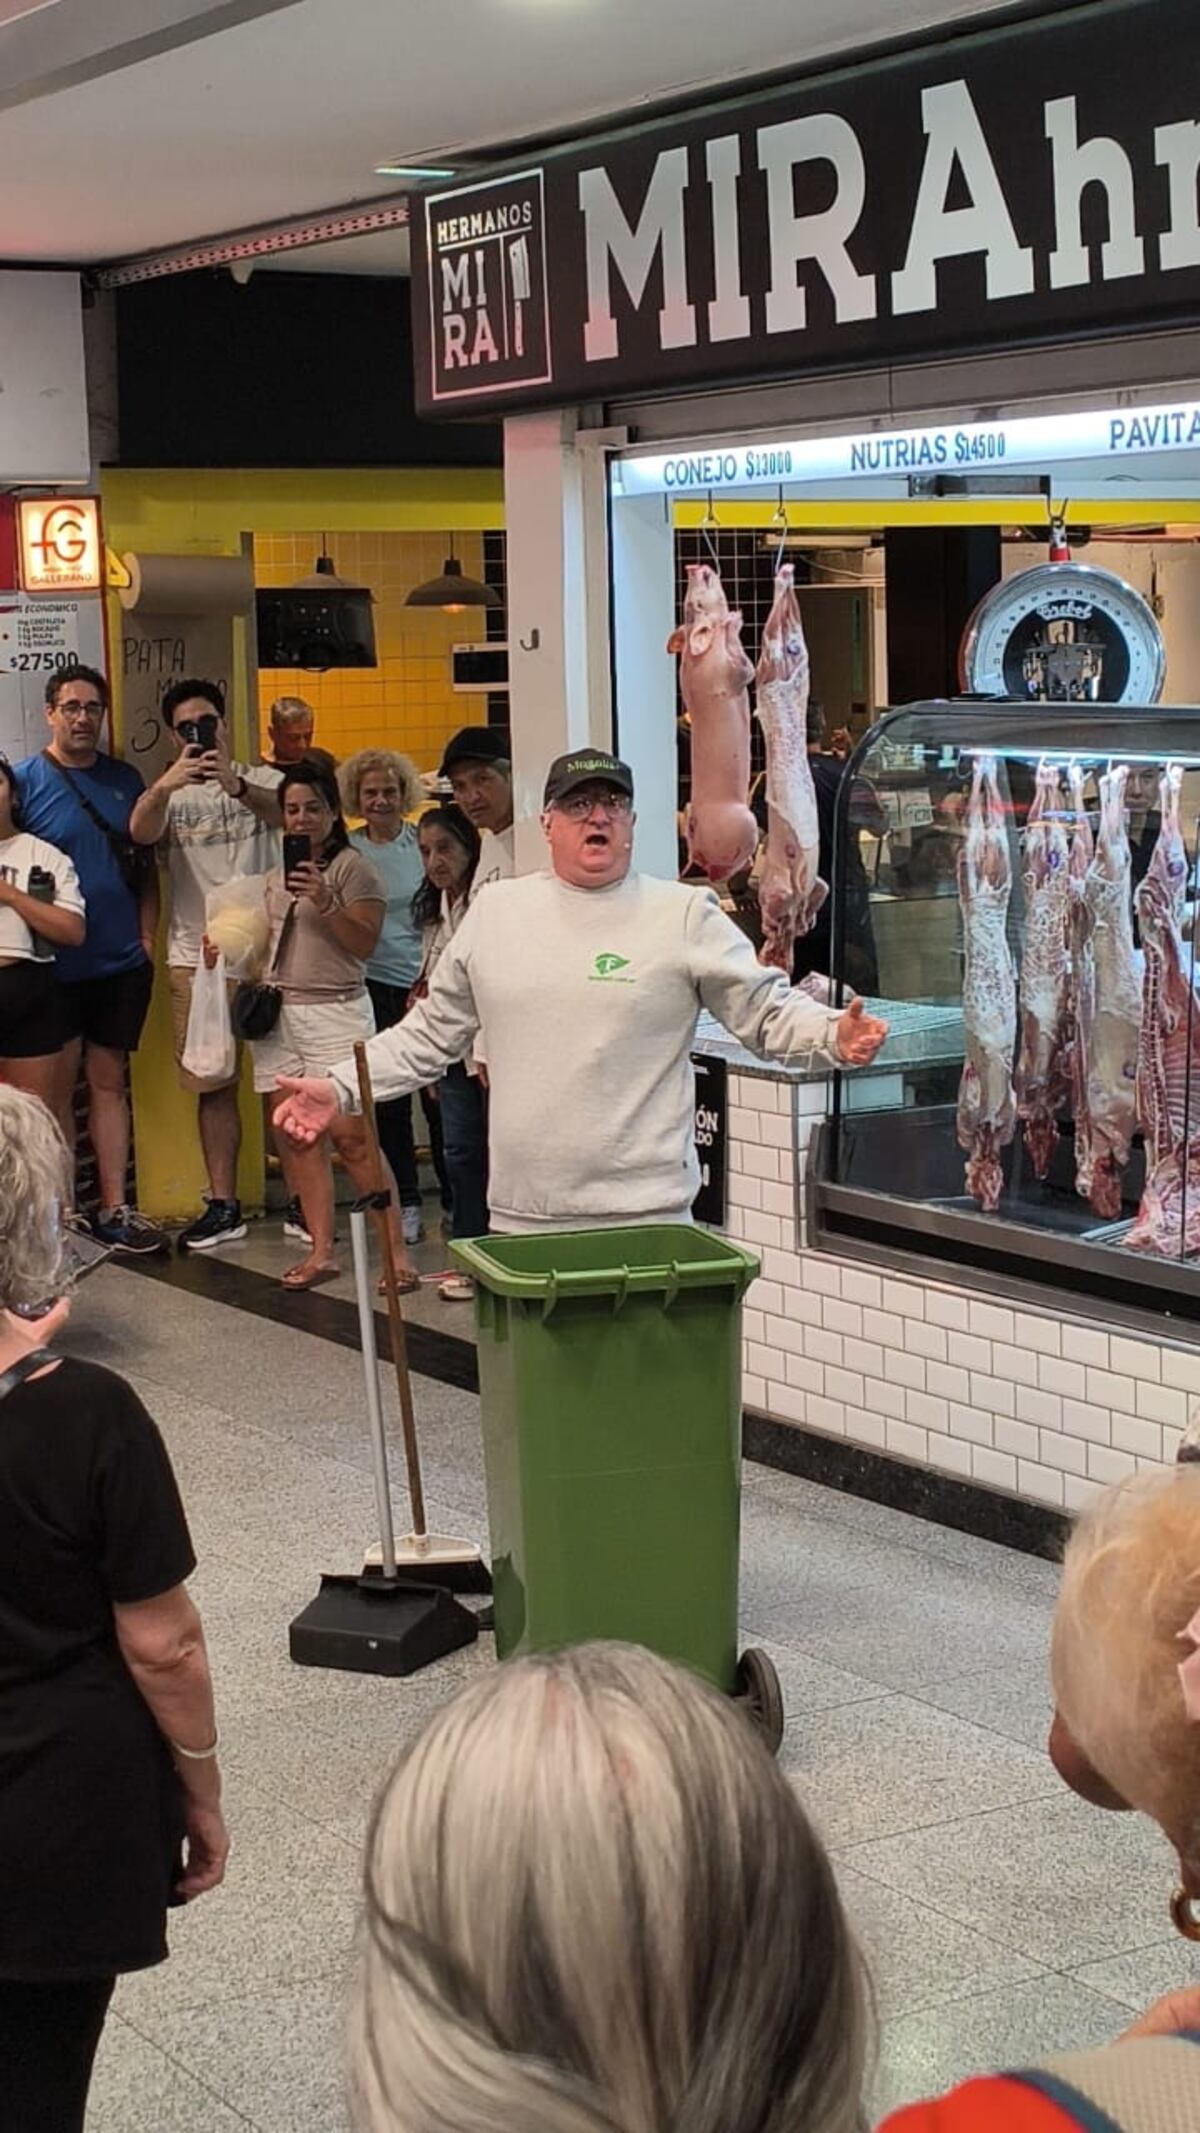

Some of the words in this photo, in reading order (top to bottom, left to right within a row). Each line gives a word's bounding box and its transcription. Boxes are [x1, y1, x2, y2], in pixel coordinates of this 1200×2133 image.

[437, 200, 533, 244] HERMANOS
[441, 249, 488, 313] MI
[443, 308, 499, 370] RA
[664, 454, 738, 487] CONEJO
[746, 450, 793, 480] $13000
[850, 434, 948, 471] NUTRIAS
[954, 431, 1006, 463] $14500
[10, 651, 79, 671] $27500
[123, 637, 186, 675] PATA
